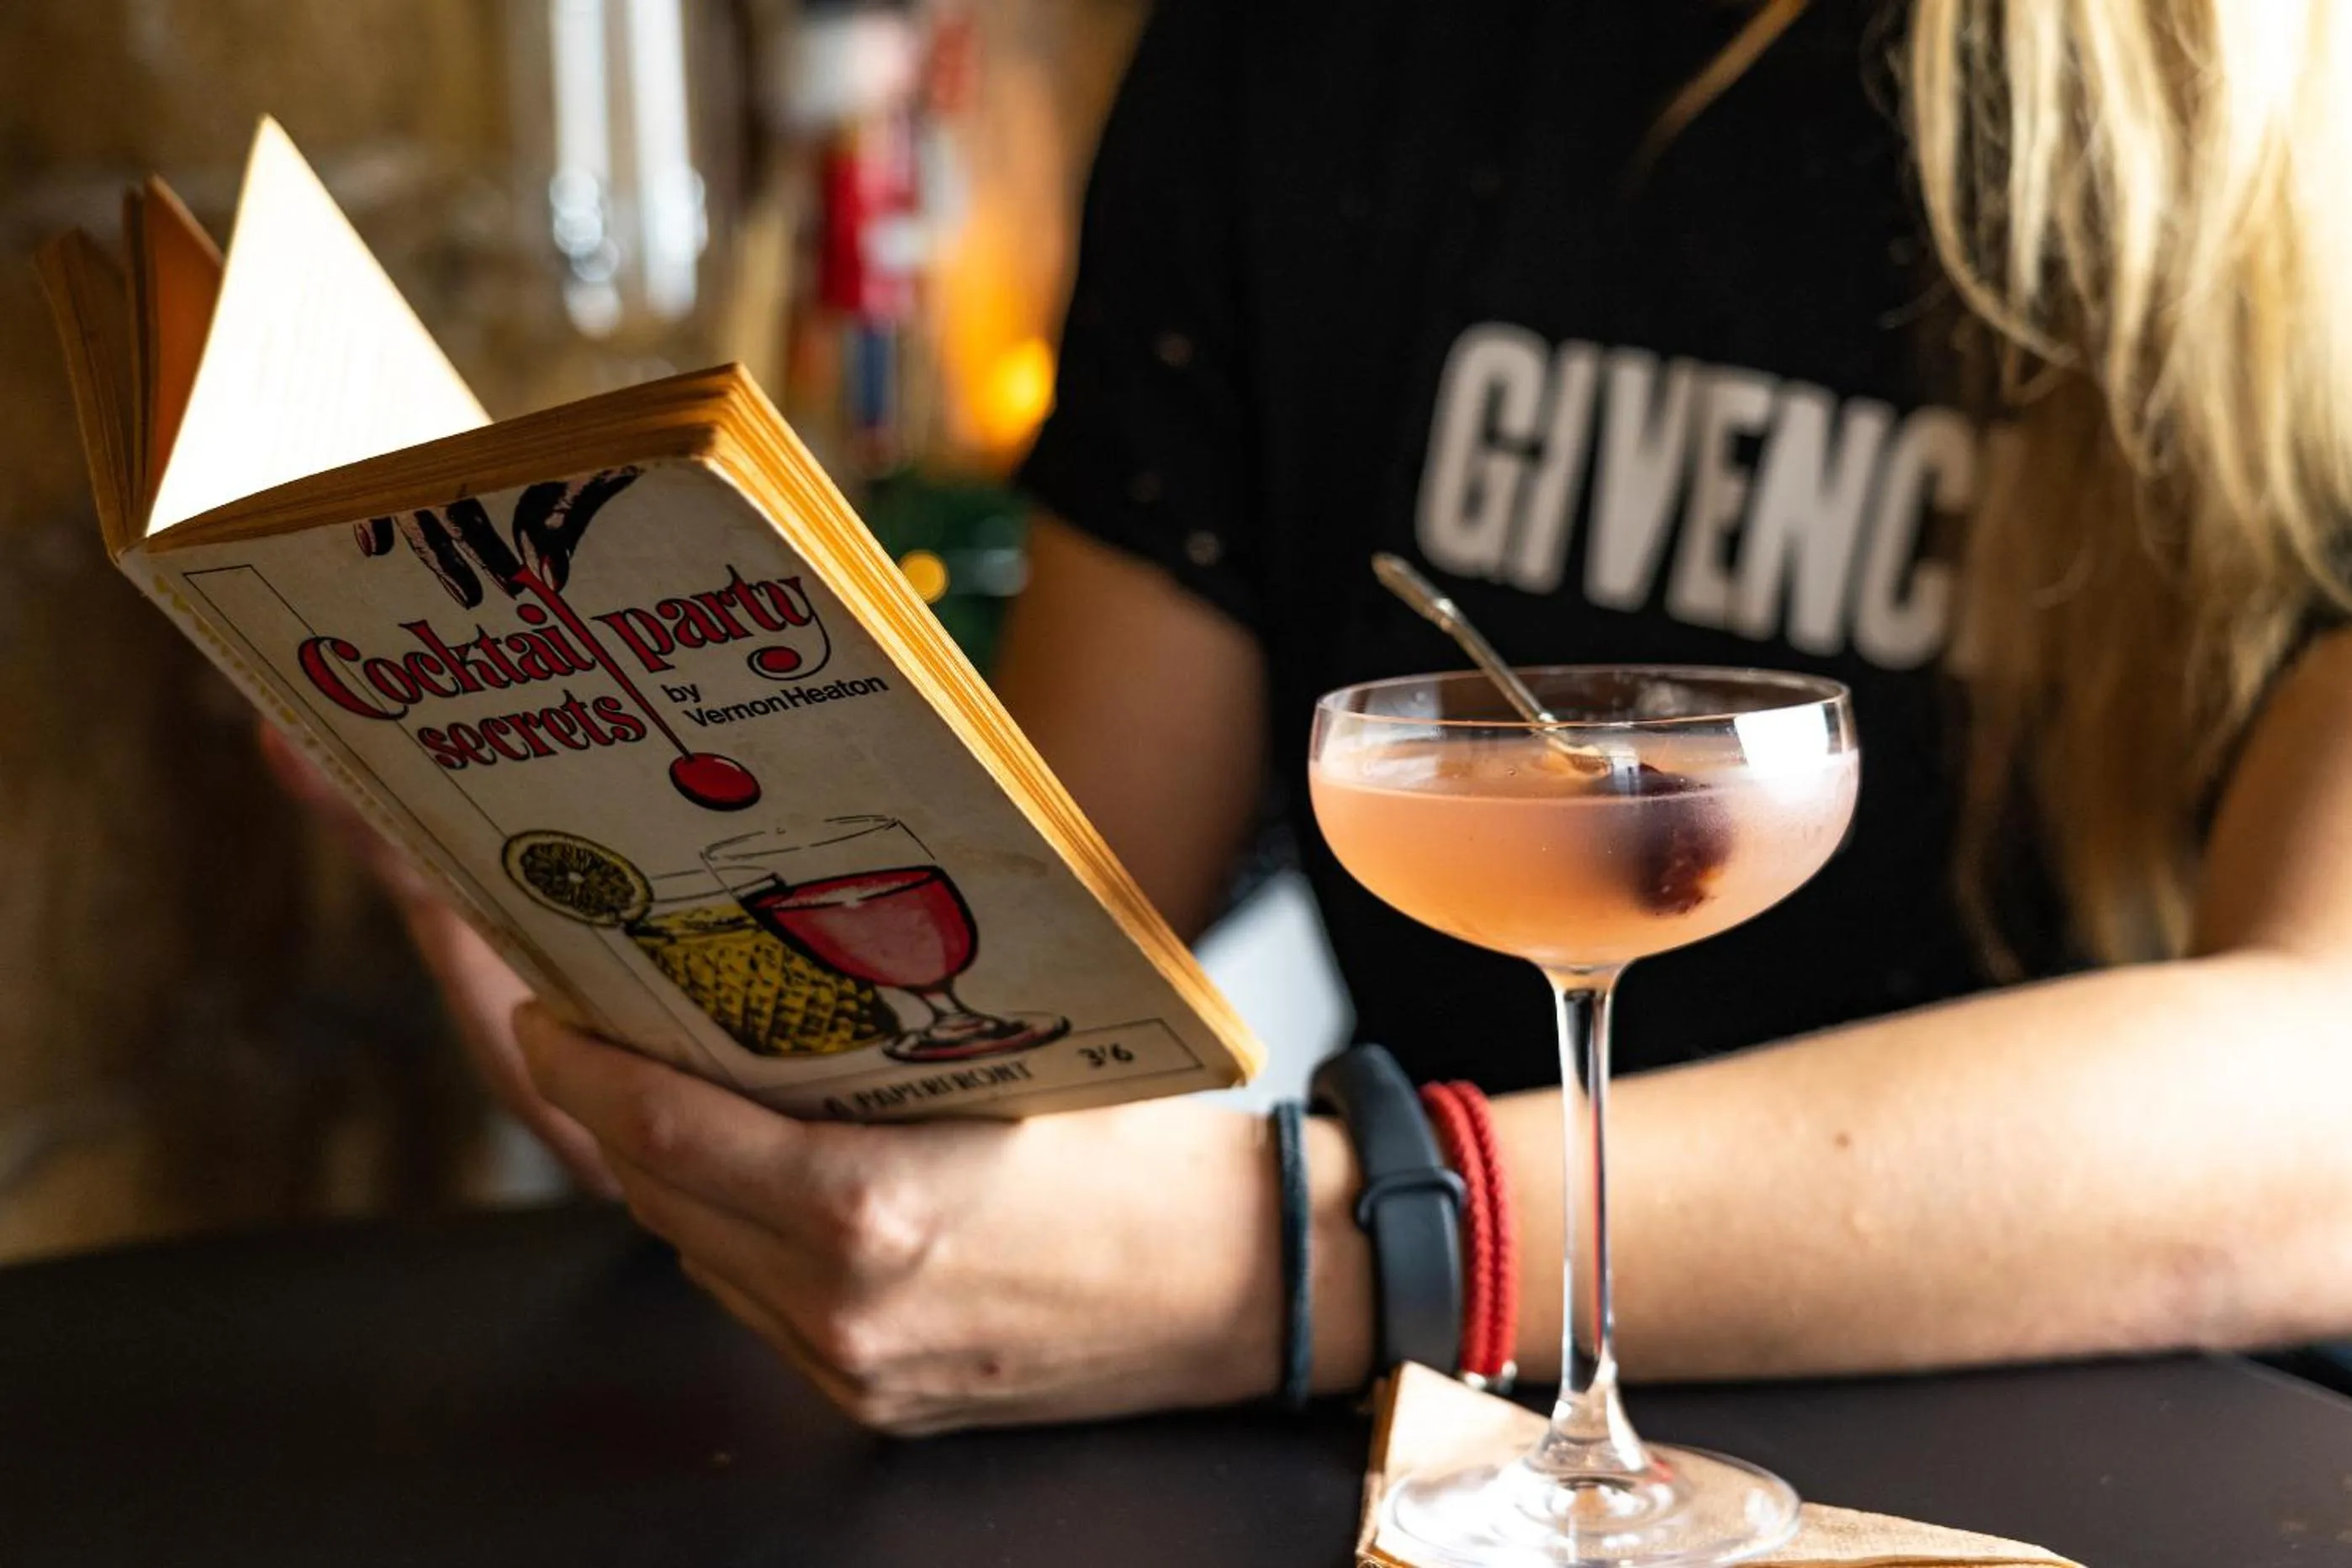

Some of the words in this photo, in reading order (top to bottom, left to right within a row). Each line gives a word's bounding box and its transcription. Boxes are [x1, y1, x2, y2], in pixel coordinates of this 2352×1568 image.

[1415, 320, 2006, 675] GIVENC
[298, 568, 602, 721] Cocktail
[592, 564, 831, 681] party
[417, 689, 647, 770] secrets
[660, 683, 702, 704] by
[682, 694, 790, 728] Vernon
[781, 675, 891, 709] Heaton
